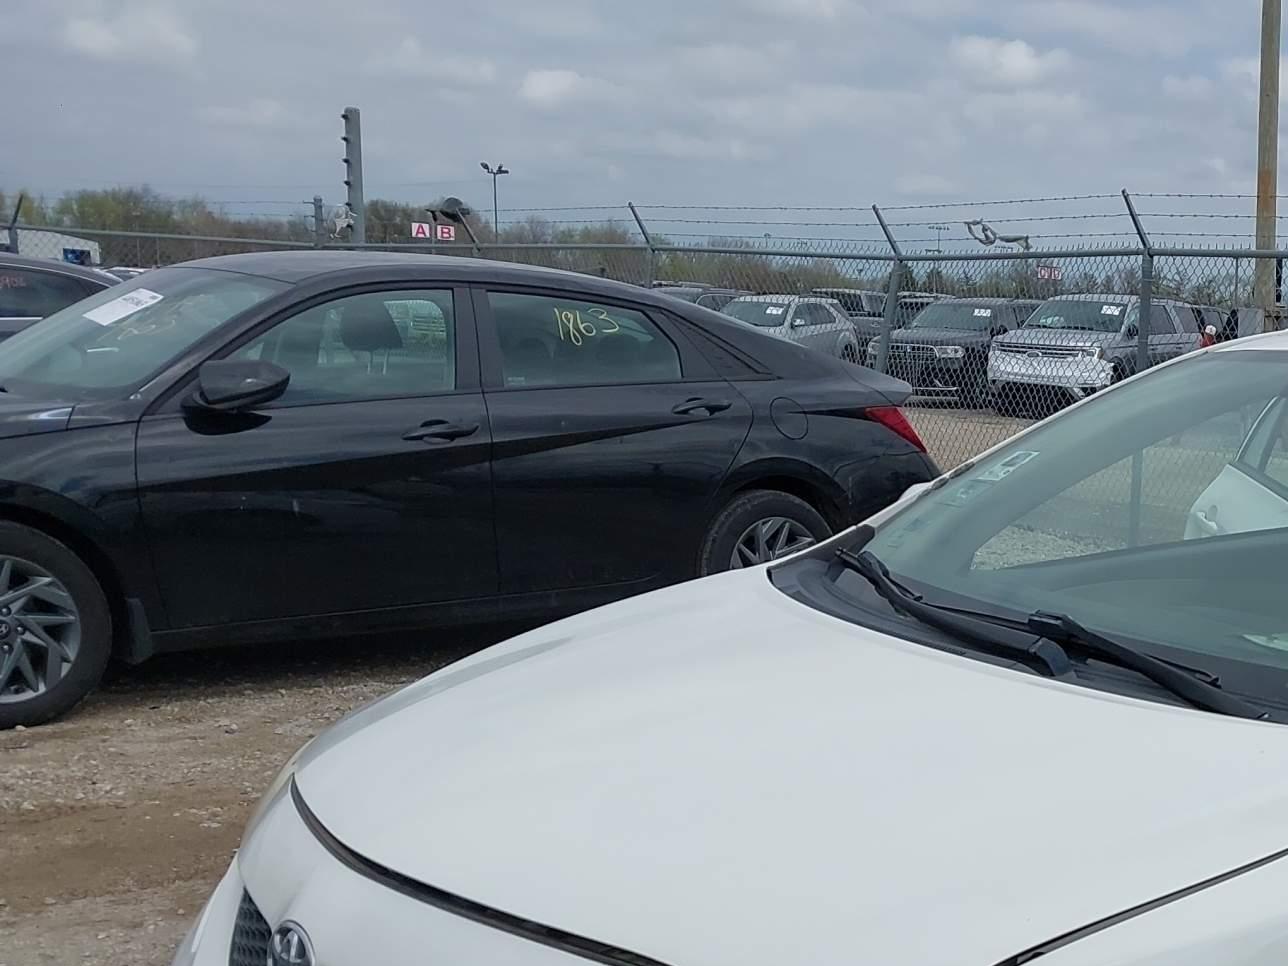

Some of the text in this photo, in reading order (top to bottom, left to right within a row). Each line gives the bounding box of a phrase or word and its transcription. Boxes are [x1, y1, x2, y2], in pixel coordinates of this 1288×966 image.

[415, 223, 426, 237] A
[441, 226, 451, 239] B
[554, 307, 619, 346] 1863
